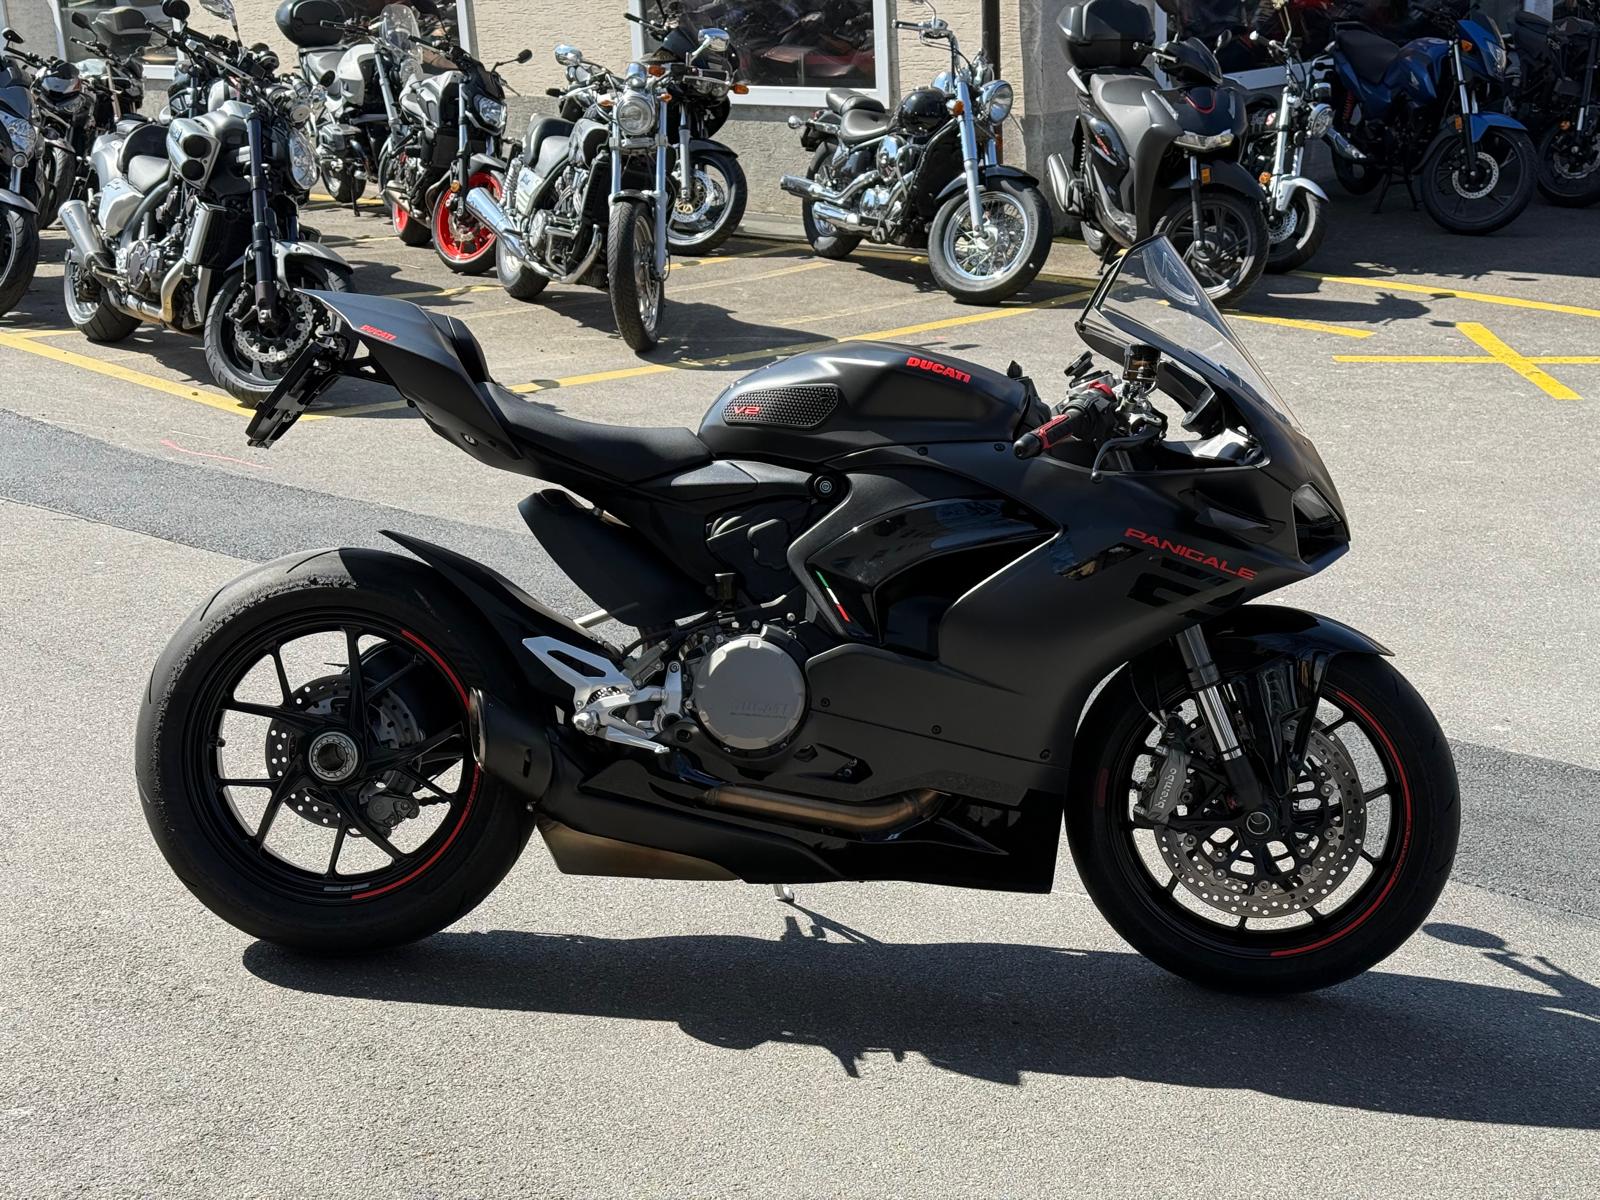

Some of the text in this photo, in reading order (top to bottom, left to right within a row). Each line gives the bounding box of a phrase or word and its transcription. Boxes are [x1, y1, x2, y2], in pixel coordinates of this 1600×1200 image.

[906, 357, 971, 384] DUCATI
[734, 406, 760, 415] V2
[1124, 527, 1258, 581] PANIGALE
[1154, 767, 1177, 809] brembo
